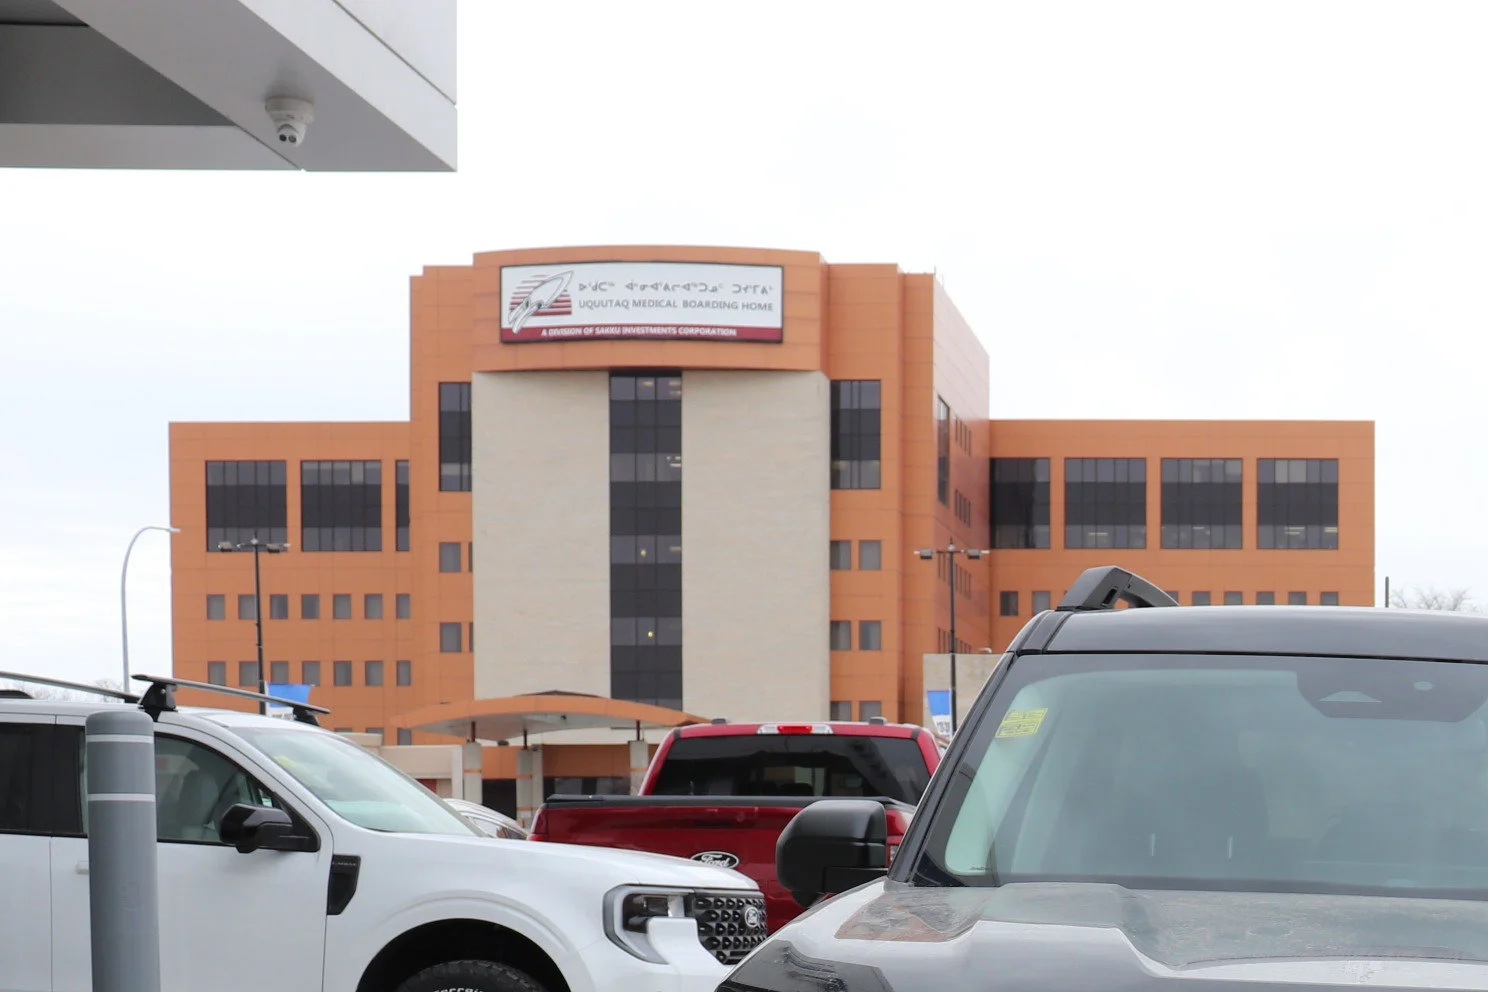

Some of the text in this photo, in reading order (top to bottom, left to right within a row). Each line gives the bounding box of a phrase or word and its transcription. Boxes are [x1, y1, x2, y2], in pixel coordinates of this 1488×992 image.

[578, 299, 773, 311] UQUUTAQ MEDICAL BOARDING HOME
[540, 326, 737, 336] A DIVISION OF SAKKU INVESTMENTS CORPORATION
[701, 854, 731, 867] Ford
